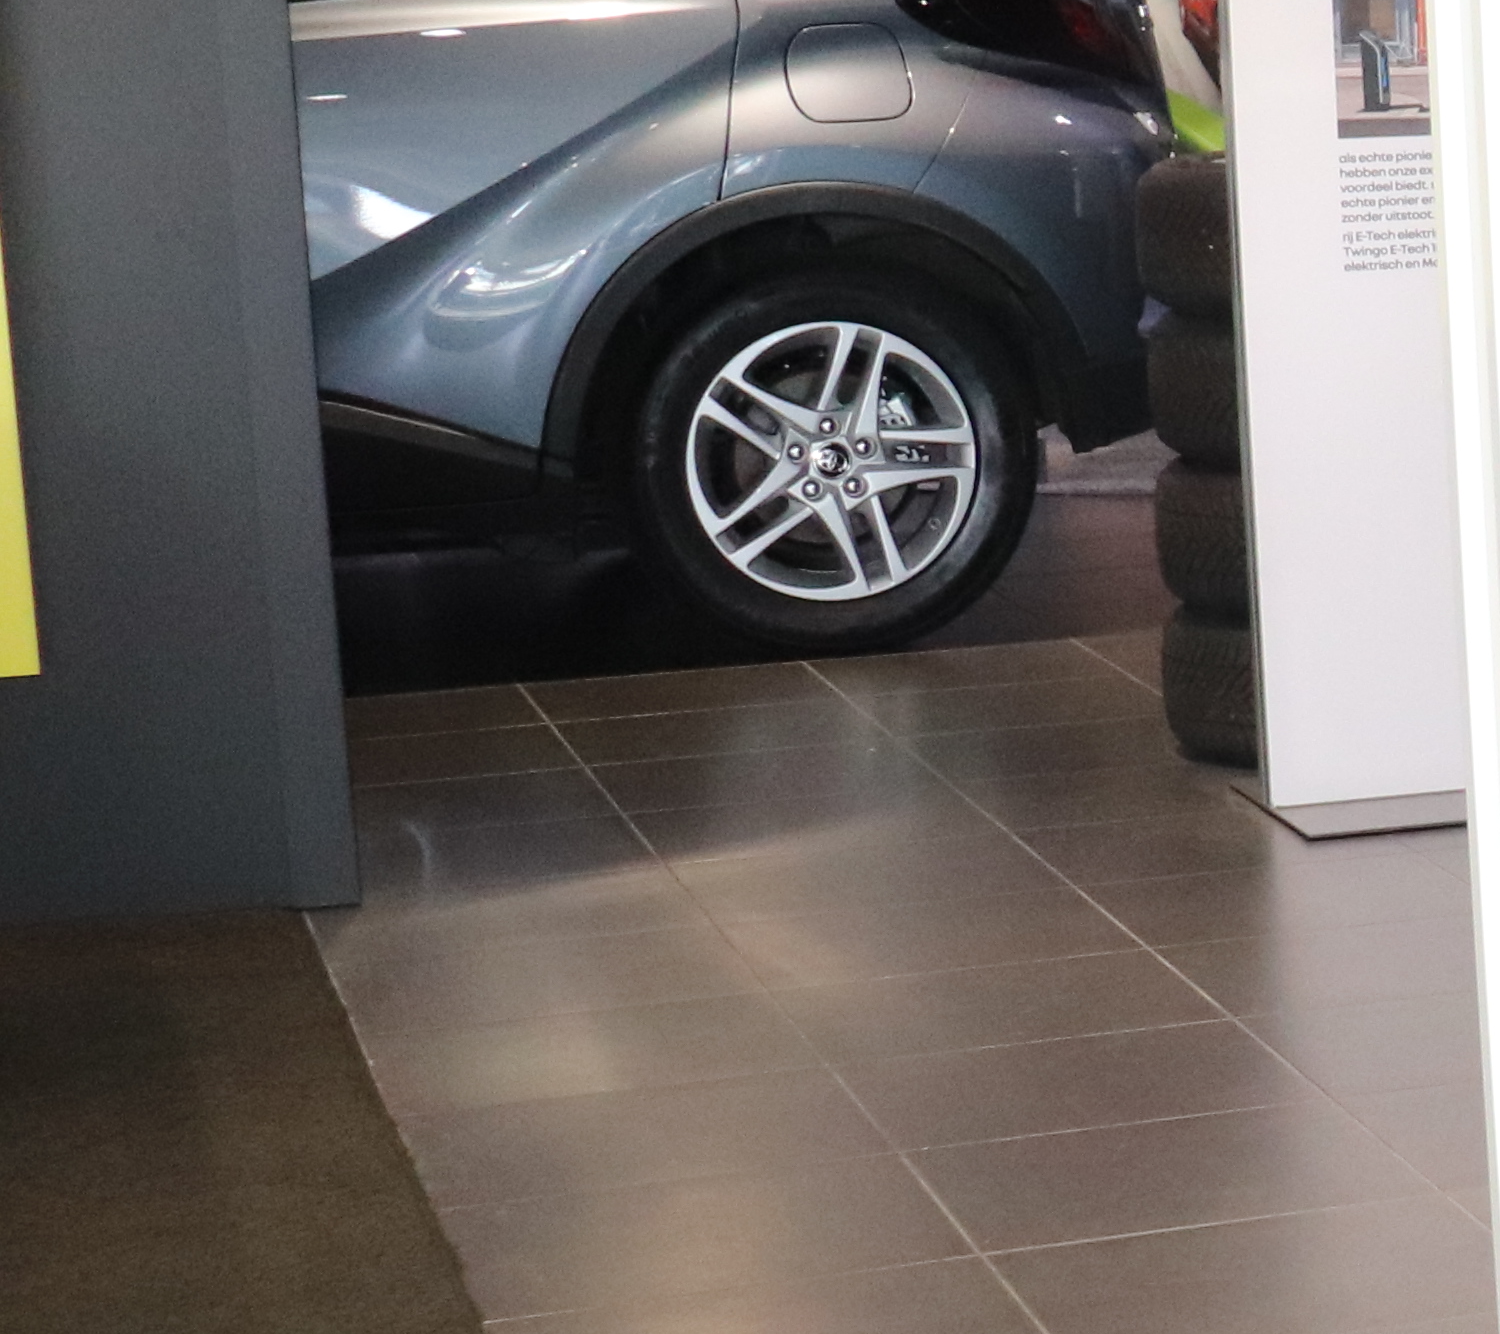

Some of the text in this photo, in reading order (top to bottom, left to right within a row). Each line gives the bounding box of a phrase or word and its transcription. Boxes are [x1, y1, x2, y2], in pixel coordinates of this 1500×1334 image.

[1339, 153, 1357, 164] als
[1358, 152, 1393, 164] echte
[1339, 167, 1386, 179] hebben
[1388, 167, 1417, 178] onze
[1340, 179, 1430, 193] voordeel biedt.
[1340, 195, 1420, 210] echte pionier
[1341, 210, 1435, 224] zonder uitstoot.
[1342, 230, 1354, 245] rij
[1356, 229, 1396, 243] E-Tech
[1343, 245, 1388, 259] Twingo
[1390, 242, 1430, 255] E-Tech
[1344, 259, 1403, 272] elektrisch
[1405, 259, 1420, 269] en
